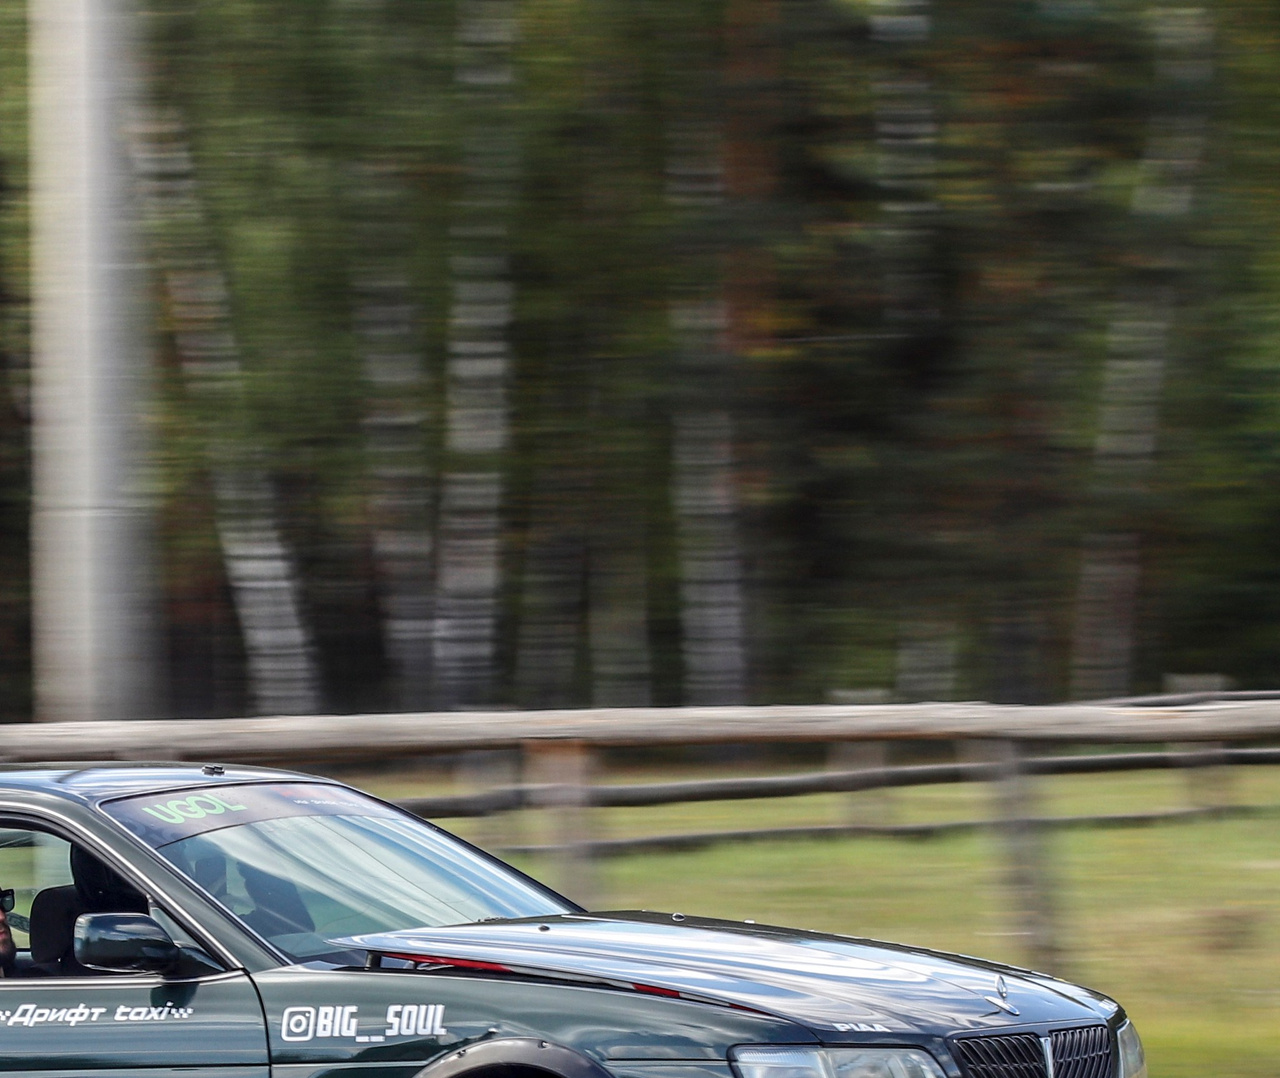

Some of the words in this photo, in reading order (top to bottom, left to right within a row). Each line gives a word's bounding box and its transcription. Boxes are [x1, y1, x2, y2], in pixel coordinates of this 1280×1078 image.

[141, 793, 248, 824] UGOL
[7, 1003, 107, 1027] Дрифт
[114, 1002, 174, 1021] taxi
[831, 1022, 893, 1033] PIAA
